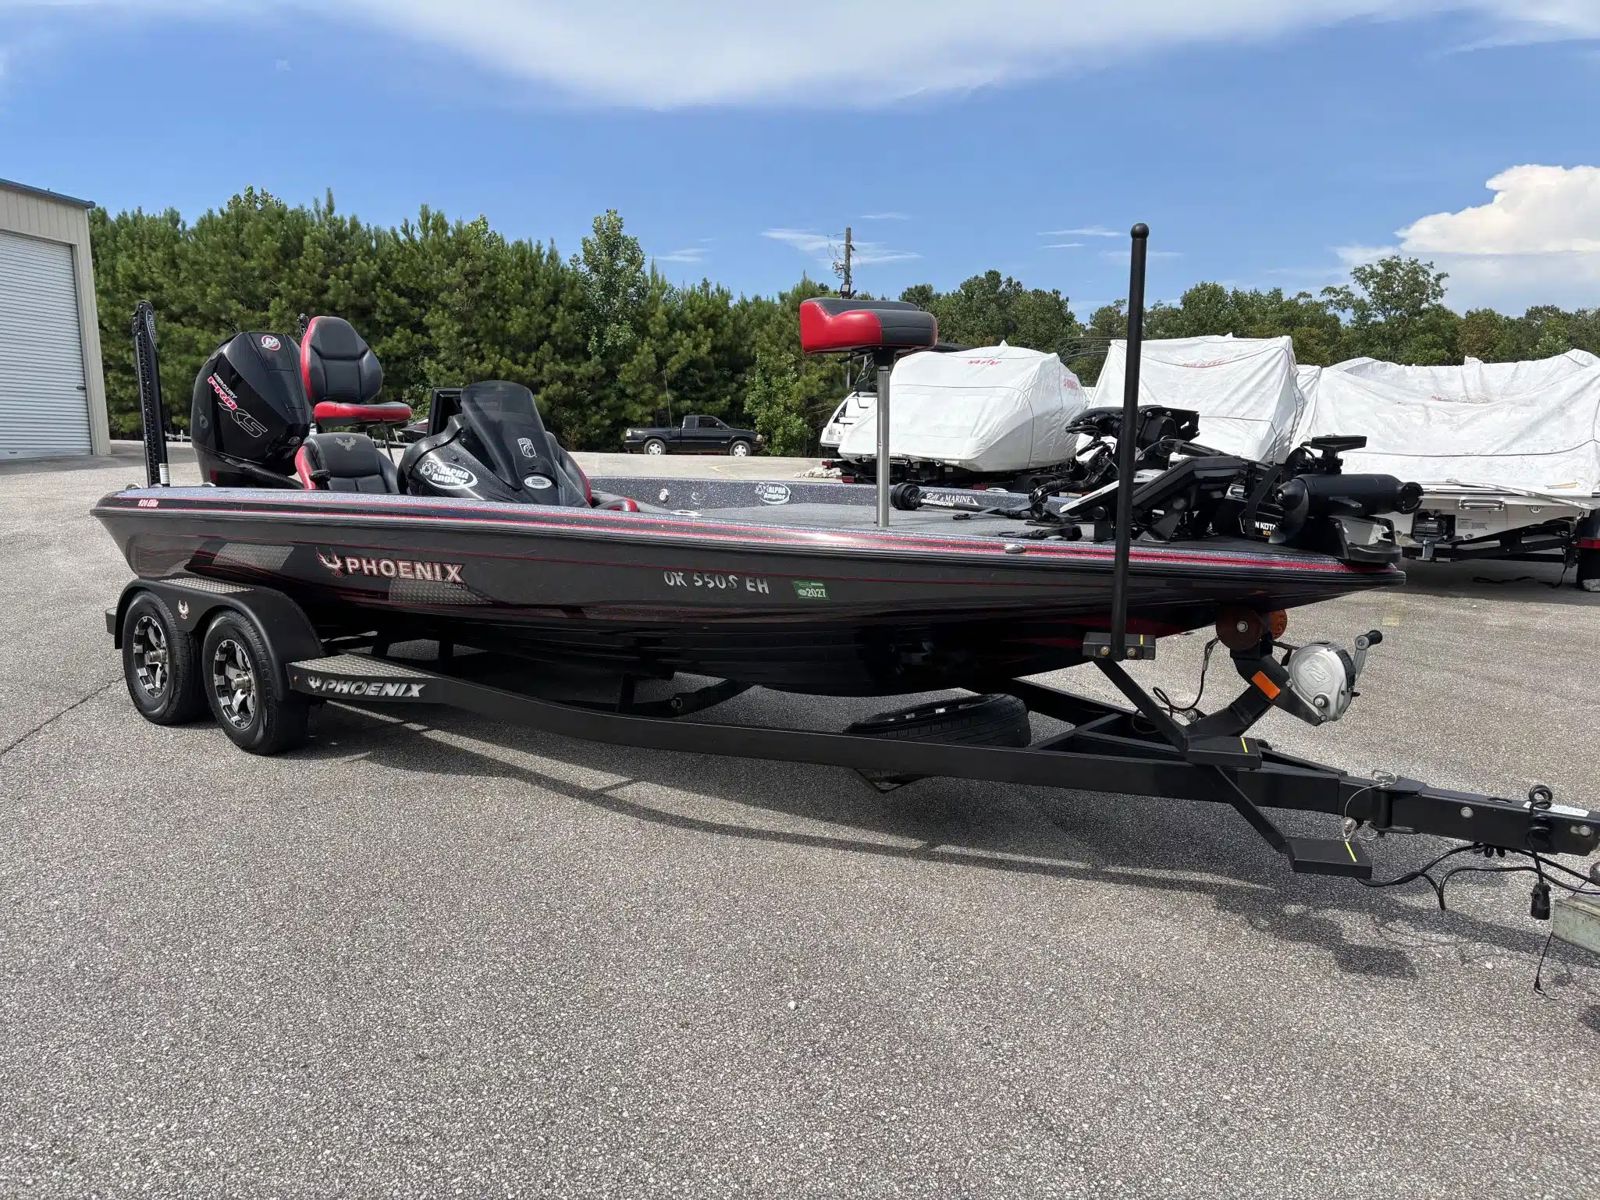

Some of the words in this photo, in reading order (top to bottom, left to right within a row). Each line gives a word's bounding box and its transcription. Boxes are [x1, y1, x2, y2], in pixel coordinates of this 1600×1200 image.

[207, 375, 238, 411] PRO
[212, 372, 238, 399] MERCURY
[218, 401, 269, 438] XS
[438, 465, 469, 480] ALPHA
[945, 494, 973, 504] MARINE
[345, 556, 464, 583] PHOENIX
[746, 576, 770, 595] EH
[805, 588, 826, 598] 2027
[321, 679, 426, 698] PHOENIX
